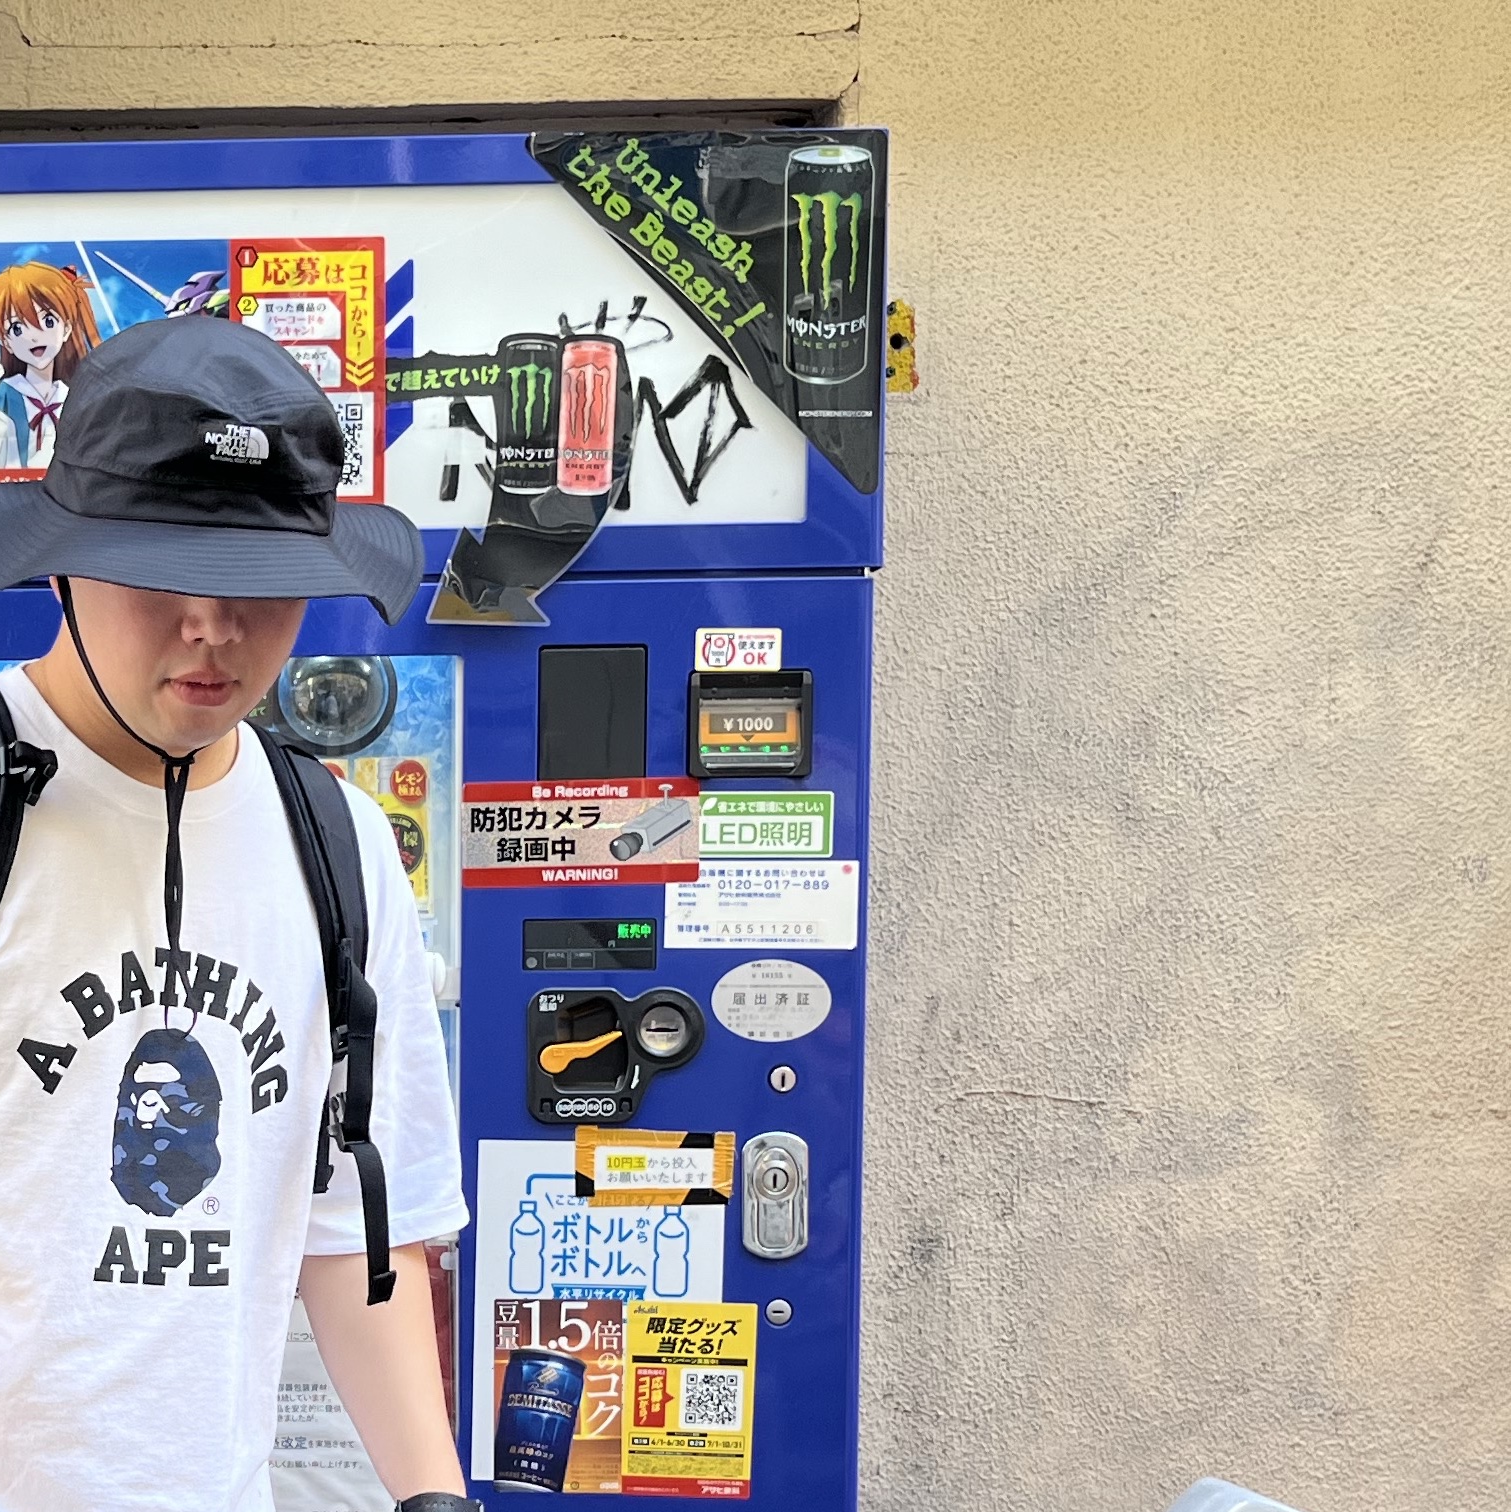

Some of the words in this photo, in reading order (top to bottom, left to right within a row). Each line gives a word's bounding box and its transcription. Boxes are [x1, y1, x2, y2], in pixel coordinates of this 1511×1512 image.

[568, 145, 632, 223] the
[615, 139, 754, 284] Unleash
[262, 257, 345, 286] 応募は
[265, 303, 327, 313] 買った商品の
[348, 263, 368, 357] ココから!
[786, 315, 867, 338] MONSTER
[204, 431, 249, 448] NORTH
[225, 424, 250, 438] THE
[215, 444, 247, 458] FACE
[738, 641, 776, 651] 使えます
[743, 652, 768, 666] OK
[723, 717, 774, 732] ¥1000
[394, 770, 425, 787] レモン
[532, 786, 551, 798] Be
[555, 784, 629, 798] Recording
[717, 801, 825, 813] 省エネで環境にやさしい
[470, 806, 602, 833] 防犯カメラ
[701, 822, 813, 847] LED照明
[496, 836, 576, 863] 録画中
[541, 868, 619, 882] WARNING!
[717, 879, 830, 891] 0120-017-889
[617, 923, 652, 939] 販売中
[677, 925, 710, 933] 管理番号
[732, 992, 811, 1006] 届出済証
[16, 1037, 78, 1096] A
[59, 946, 289, 1115] BATHING
[606, 1156, 698, 1170] 10円玉から投入
[606, 1171, 708, 1184] お願いいたします
[93, 1226, 231, 1287] APE
[550, 1246, 647, 1278] ボトルへ
[558, 1288, 639, 1299] 水平リサイクル
[494, 1300, 520, 1351] 豆量
[521, 1300, 623, 1351] 1.5倍
[645, 1317, 743, 1336] 限定グッズ
[657, 1336, 724, 1356] 当たる!
